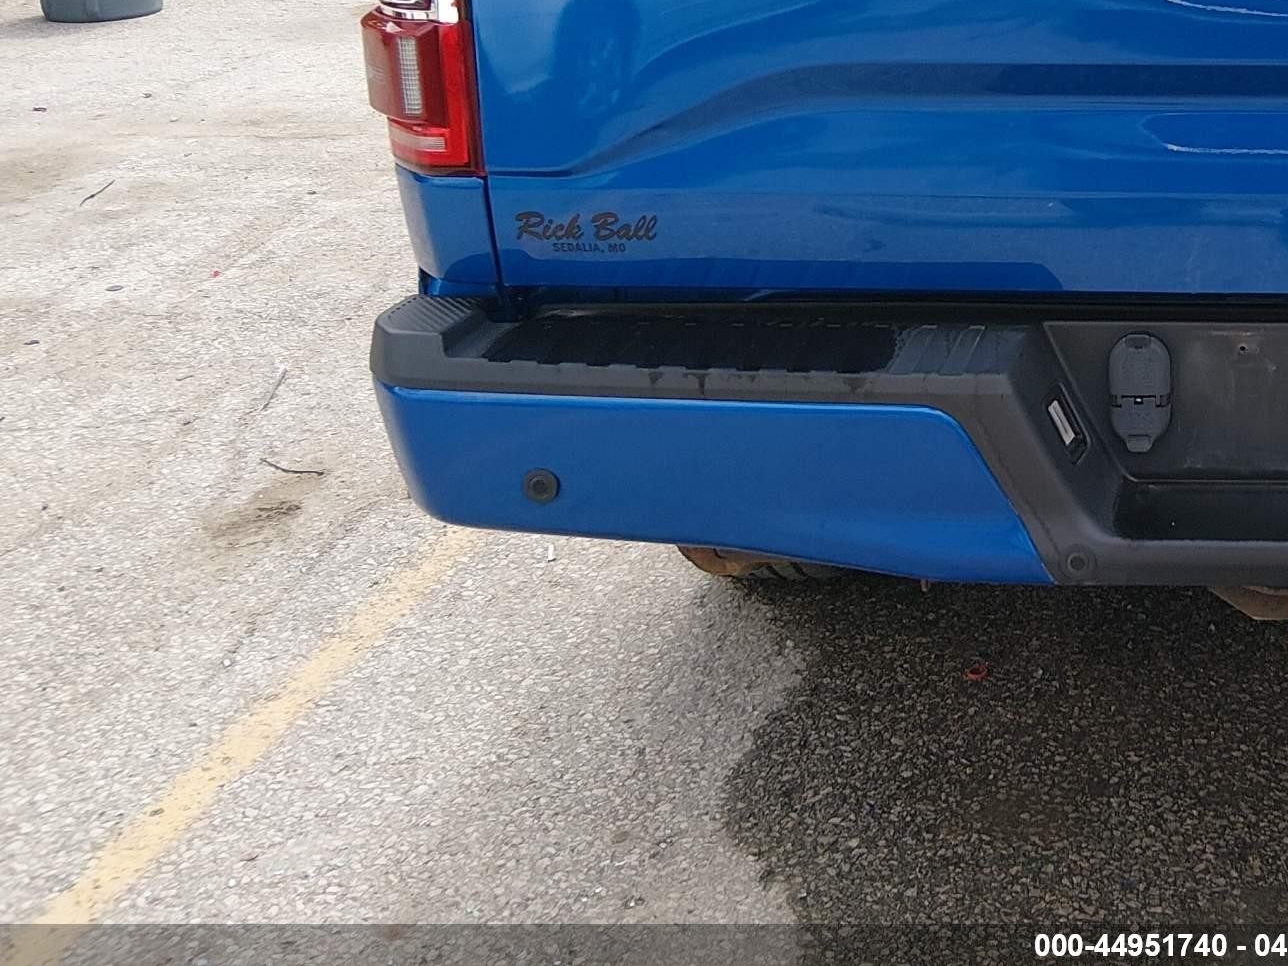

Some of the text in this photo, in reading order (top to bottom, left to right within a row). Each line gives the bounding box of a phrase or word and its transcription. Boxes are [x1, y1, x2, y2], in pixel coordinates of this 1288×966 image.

[515, 211, 658, 241] Rick Ball
[552, 242, 626, 253] SEDALIA, MO
